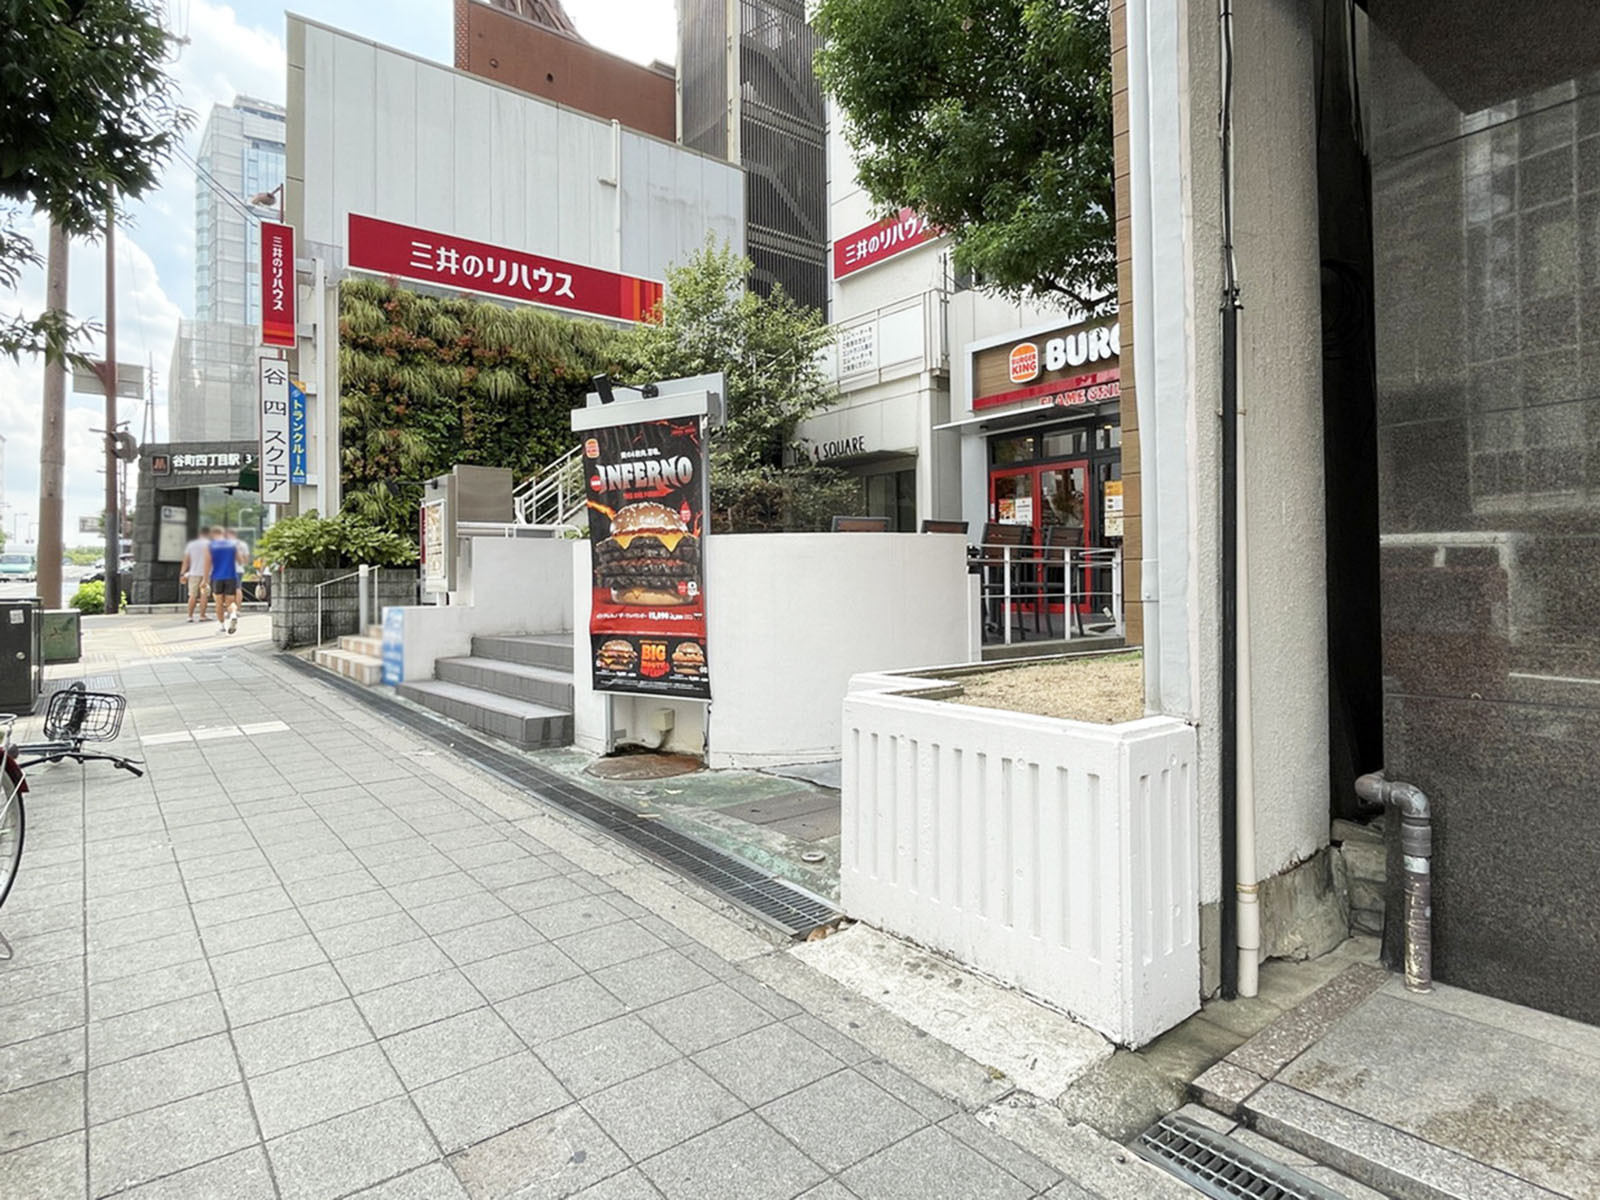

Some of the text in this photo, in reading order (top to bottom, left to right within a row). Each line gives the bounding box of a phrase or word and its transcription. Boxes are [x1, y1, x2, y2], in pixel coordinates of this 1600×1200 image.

[272, 236, 284, 311] 三井のリハウス
[410, 240, 575, 299] 三井のリハウス
[1012, 361, 1036, 375] KING
[292, 400, 305, 476] トランクルーム
[823, 435, 865, 458] SQUARE
[596, 456, 693, 494] INFERNO
[641, 644, 666, 660] BIG
